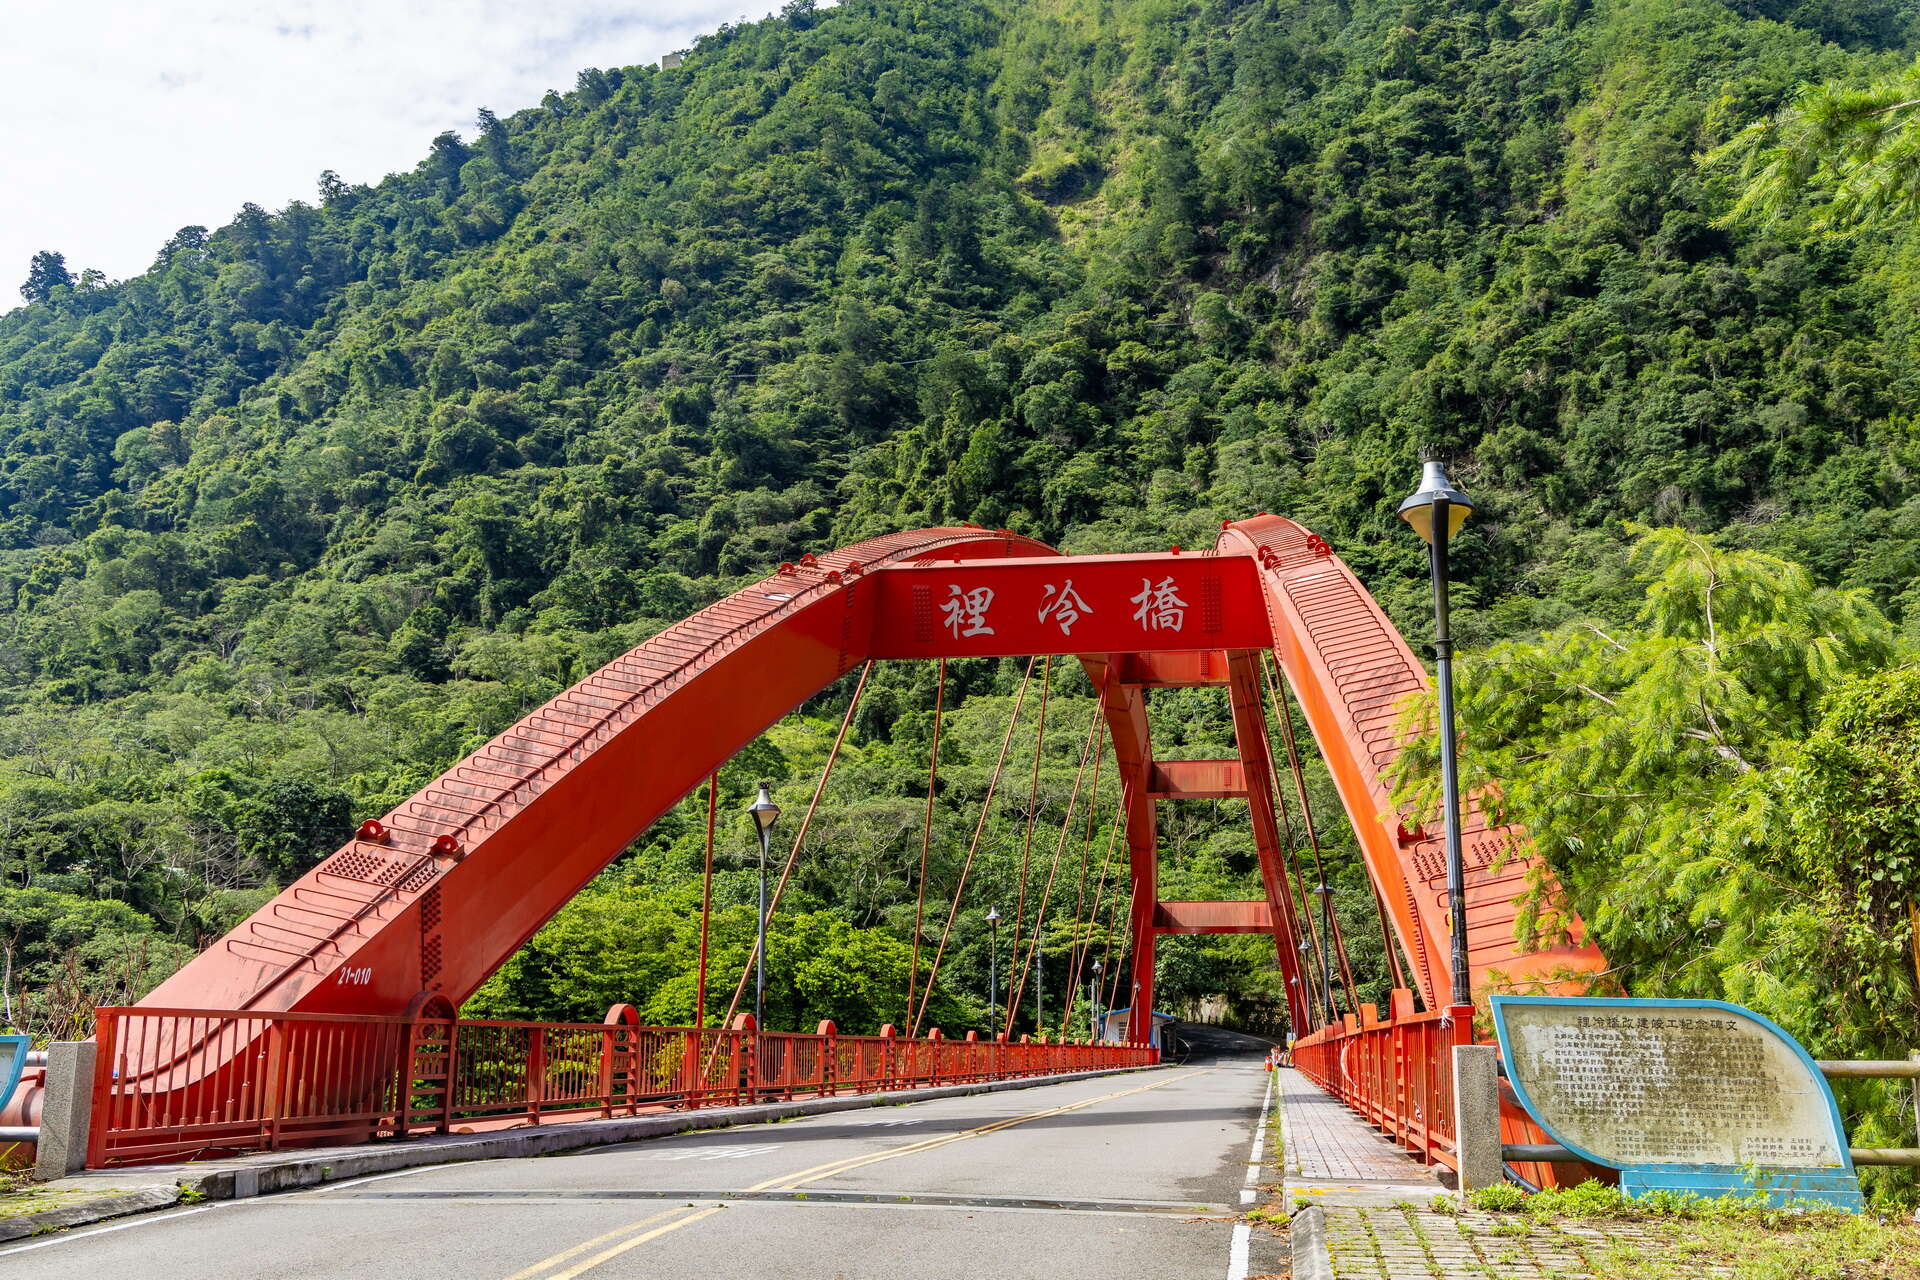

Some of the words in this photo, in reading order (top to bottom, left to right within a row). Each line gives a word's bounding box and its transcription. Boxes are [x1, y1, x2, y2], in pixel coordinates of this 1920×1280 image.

[938, 576, 1189, 641] 裡冷橋
[337, 967, 373, 985] 21-010
